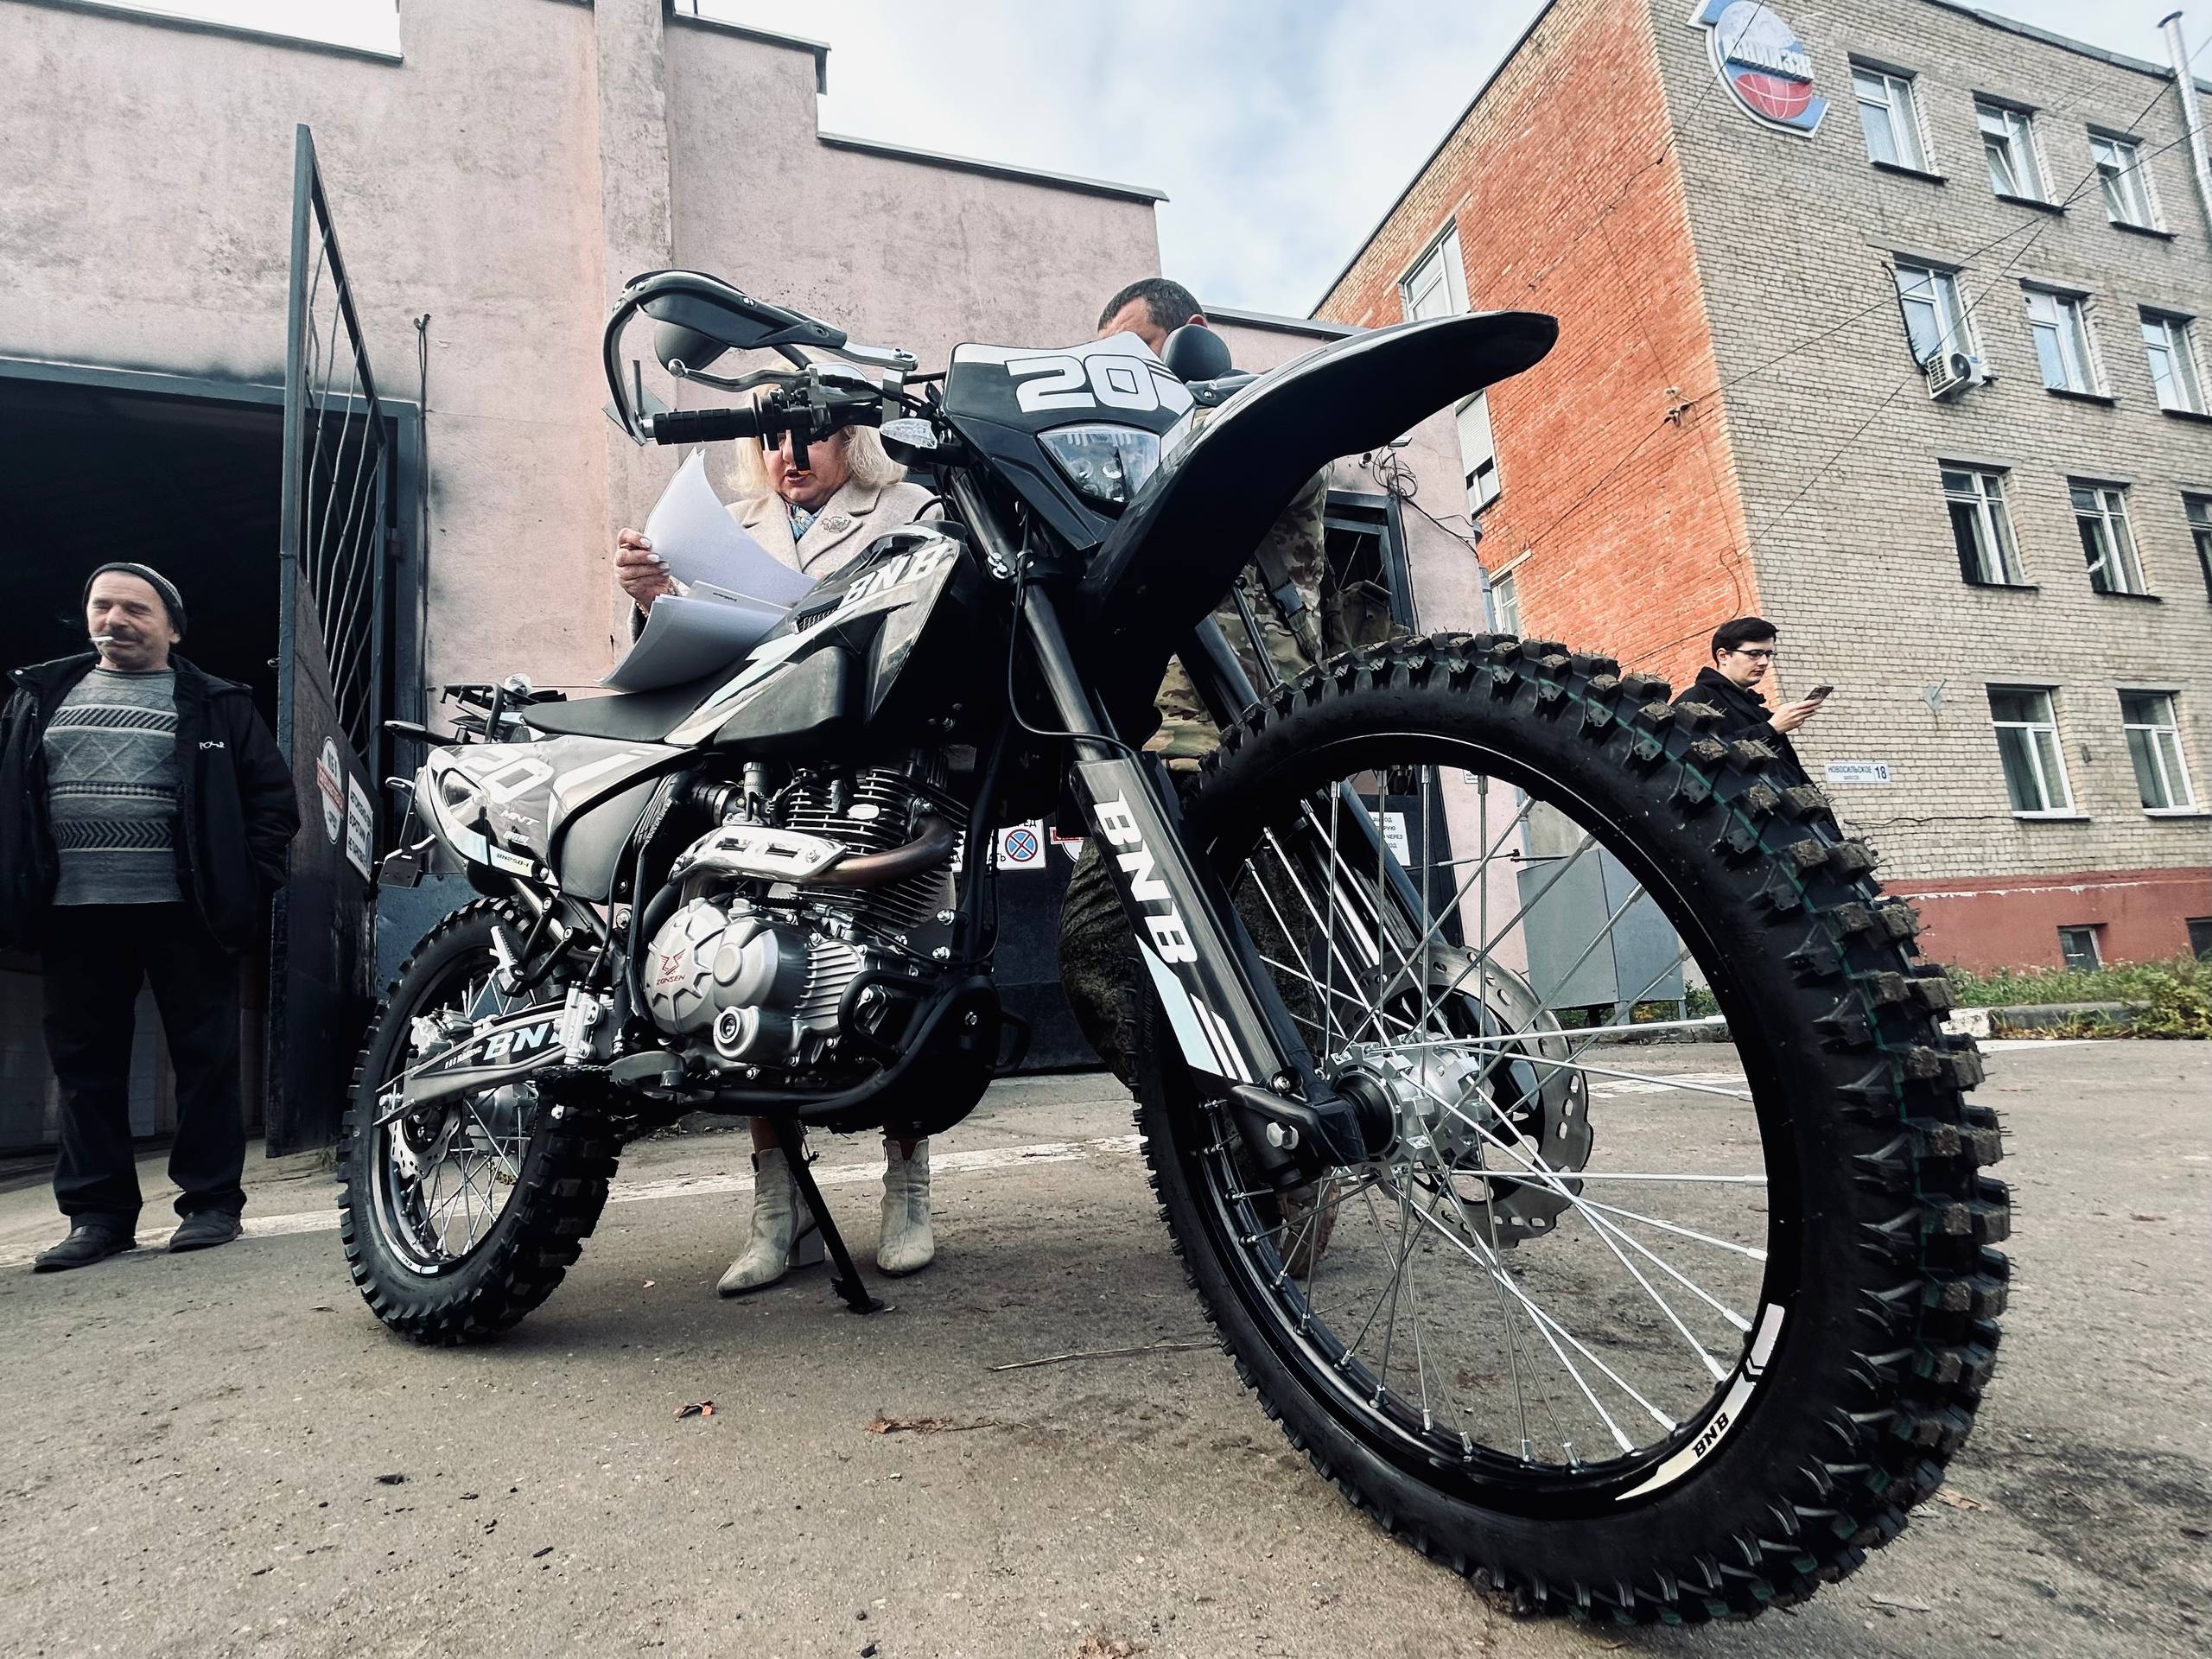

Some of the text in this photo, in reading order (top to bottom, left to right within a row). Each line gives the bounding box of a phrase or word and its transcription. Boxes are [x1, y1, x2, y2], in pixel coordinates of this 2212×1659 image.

[1005, 353, 1160, 413] 20
[836, 542, 950, 610] BNB
[1874, 766, 1887, 779] 18
[1093, 787, 1198, 965] BNB
[657, 974, 686, 986] ZONSEN
[483, 1022, 560, 1061] BN
[1691, 1412, 1730, 1459] BNB
